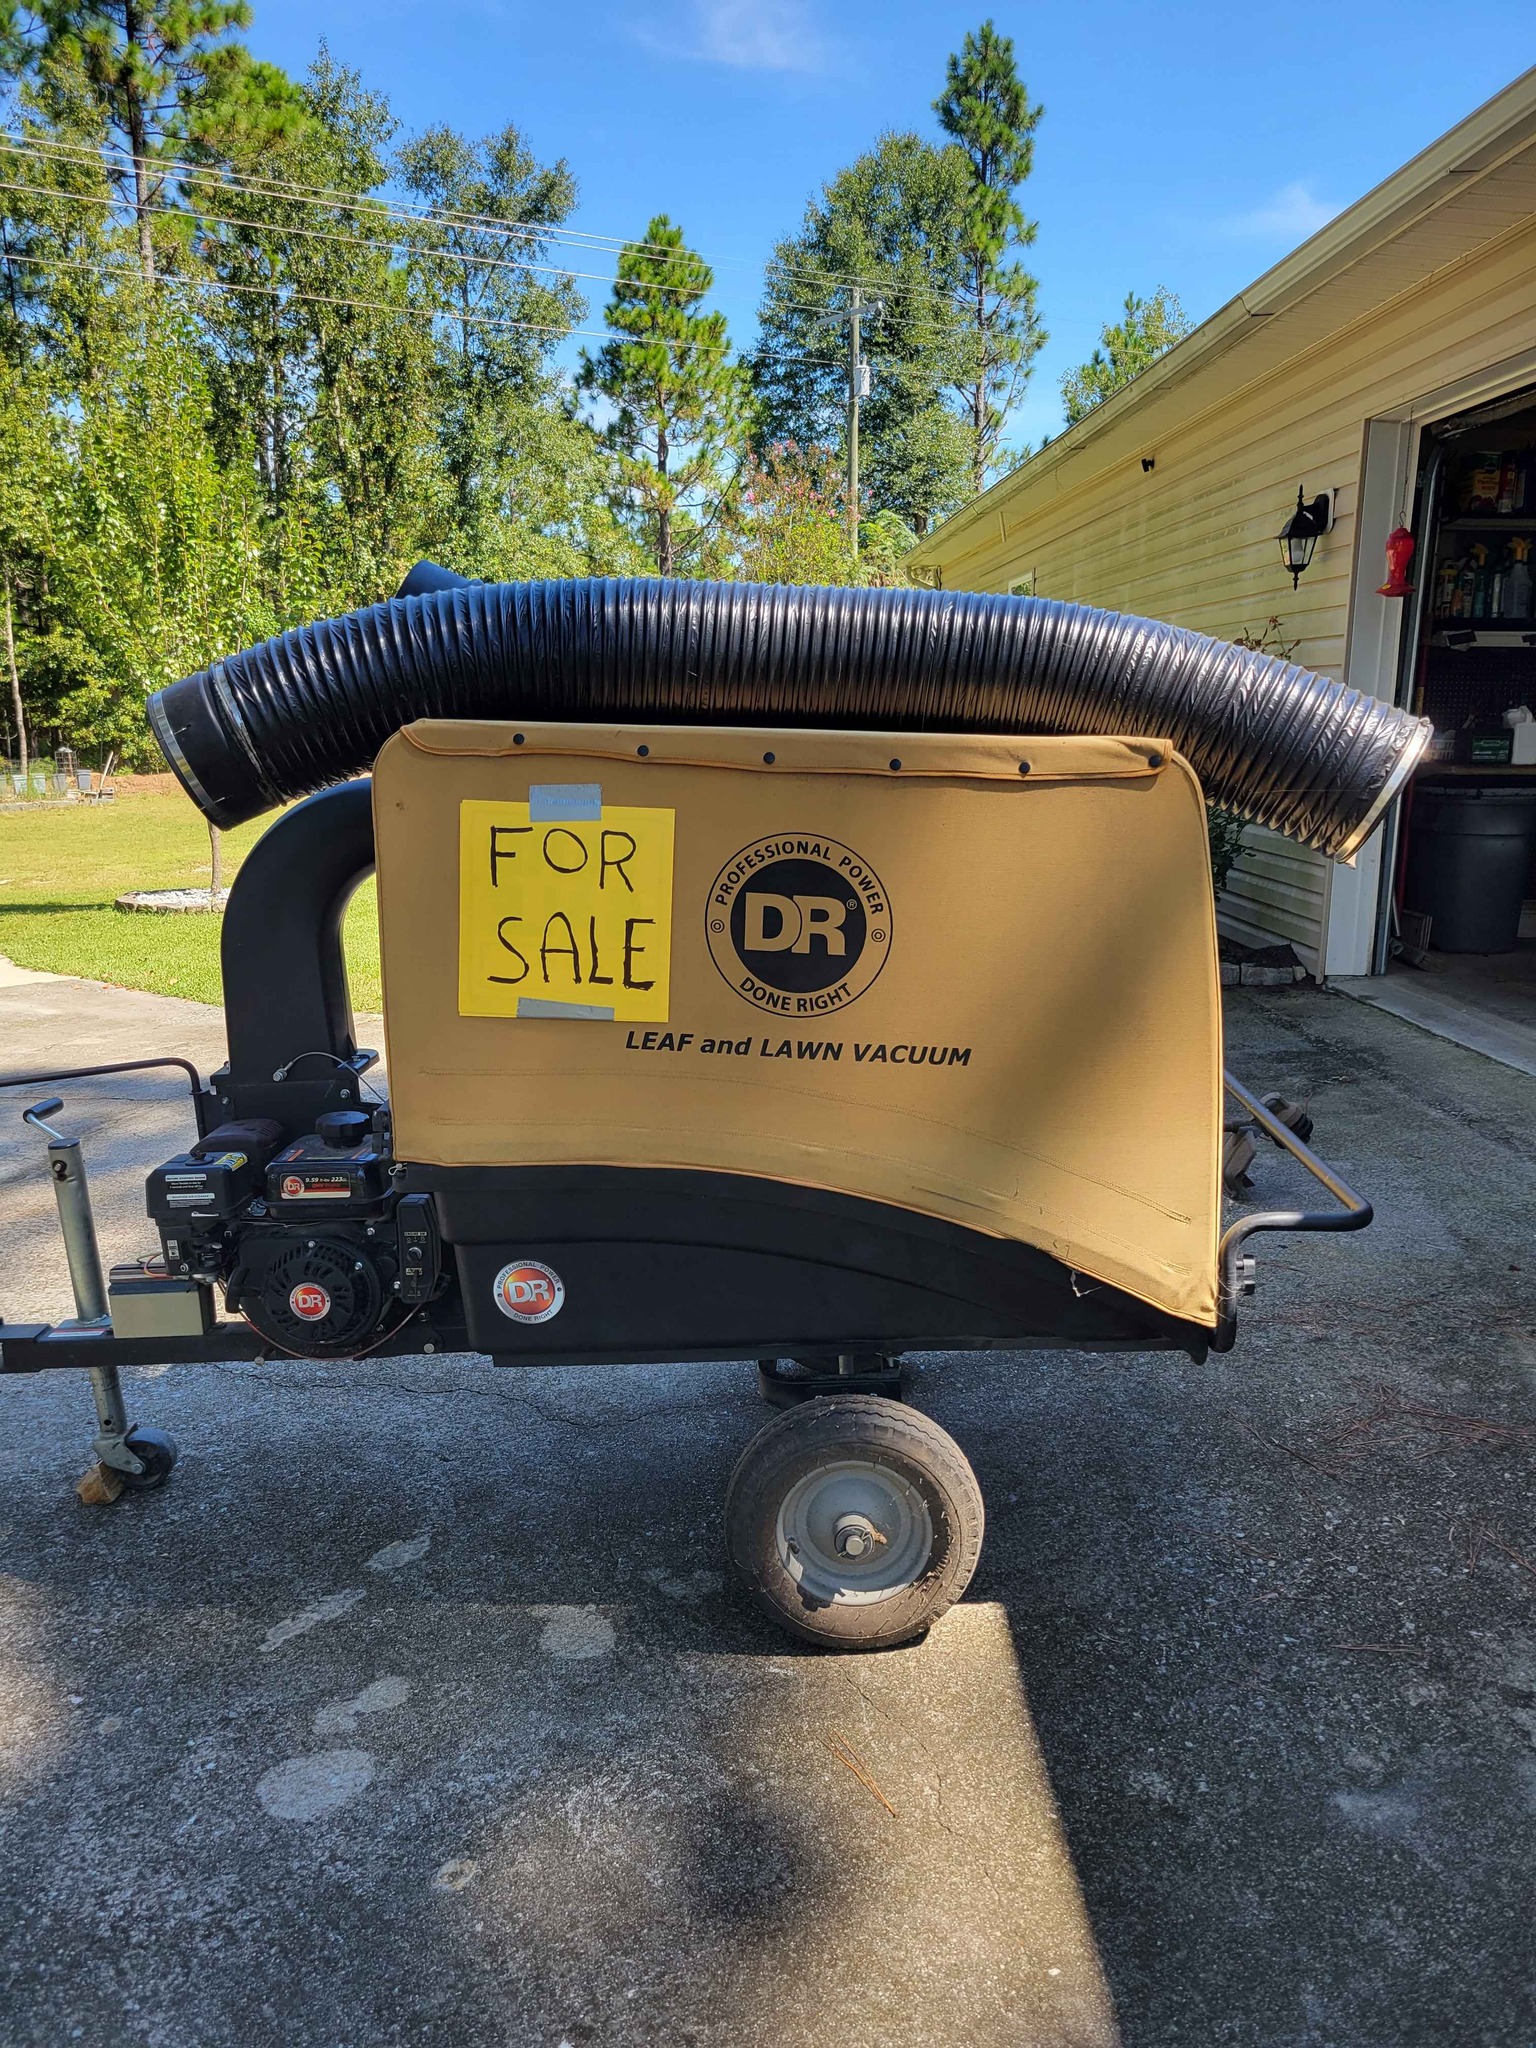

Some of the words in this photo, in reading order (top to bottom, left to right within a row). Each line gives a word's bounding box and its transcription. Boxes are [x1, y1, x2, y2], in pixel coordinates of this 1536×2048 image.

[490, 825, 637, 893] FOR
[714, 840, 833, 906] PROFESSIONAL
[838, 856, 885, 915] POWER
[487, 911, 656, 991] SALE
[739, 976, 792, 1011] DONE
[796, 982, 852, 1012] RIGHT
[625, 1031, 694, 1052] LEAF
[700, 1037, 752, 1056] and
[759, 1038, 843, 1061] LAWN
[853, 1043, 972, 1066] VACUUM
[287, 1181, 301, 1191] DR
[496, 1261, 537, 1290] PROFESSIONAL
[539, 1264, 560, 1284] POWER
[297, 1294, 323, 1309] DR
[513, 1312, 533, 1321] DONE
[534, 1309, 553, 1321] RIGHT
